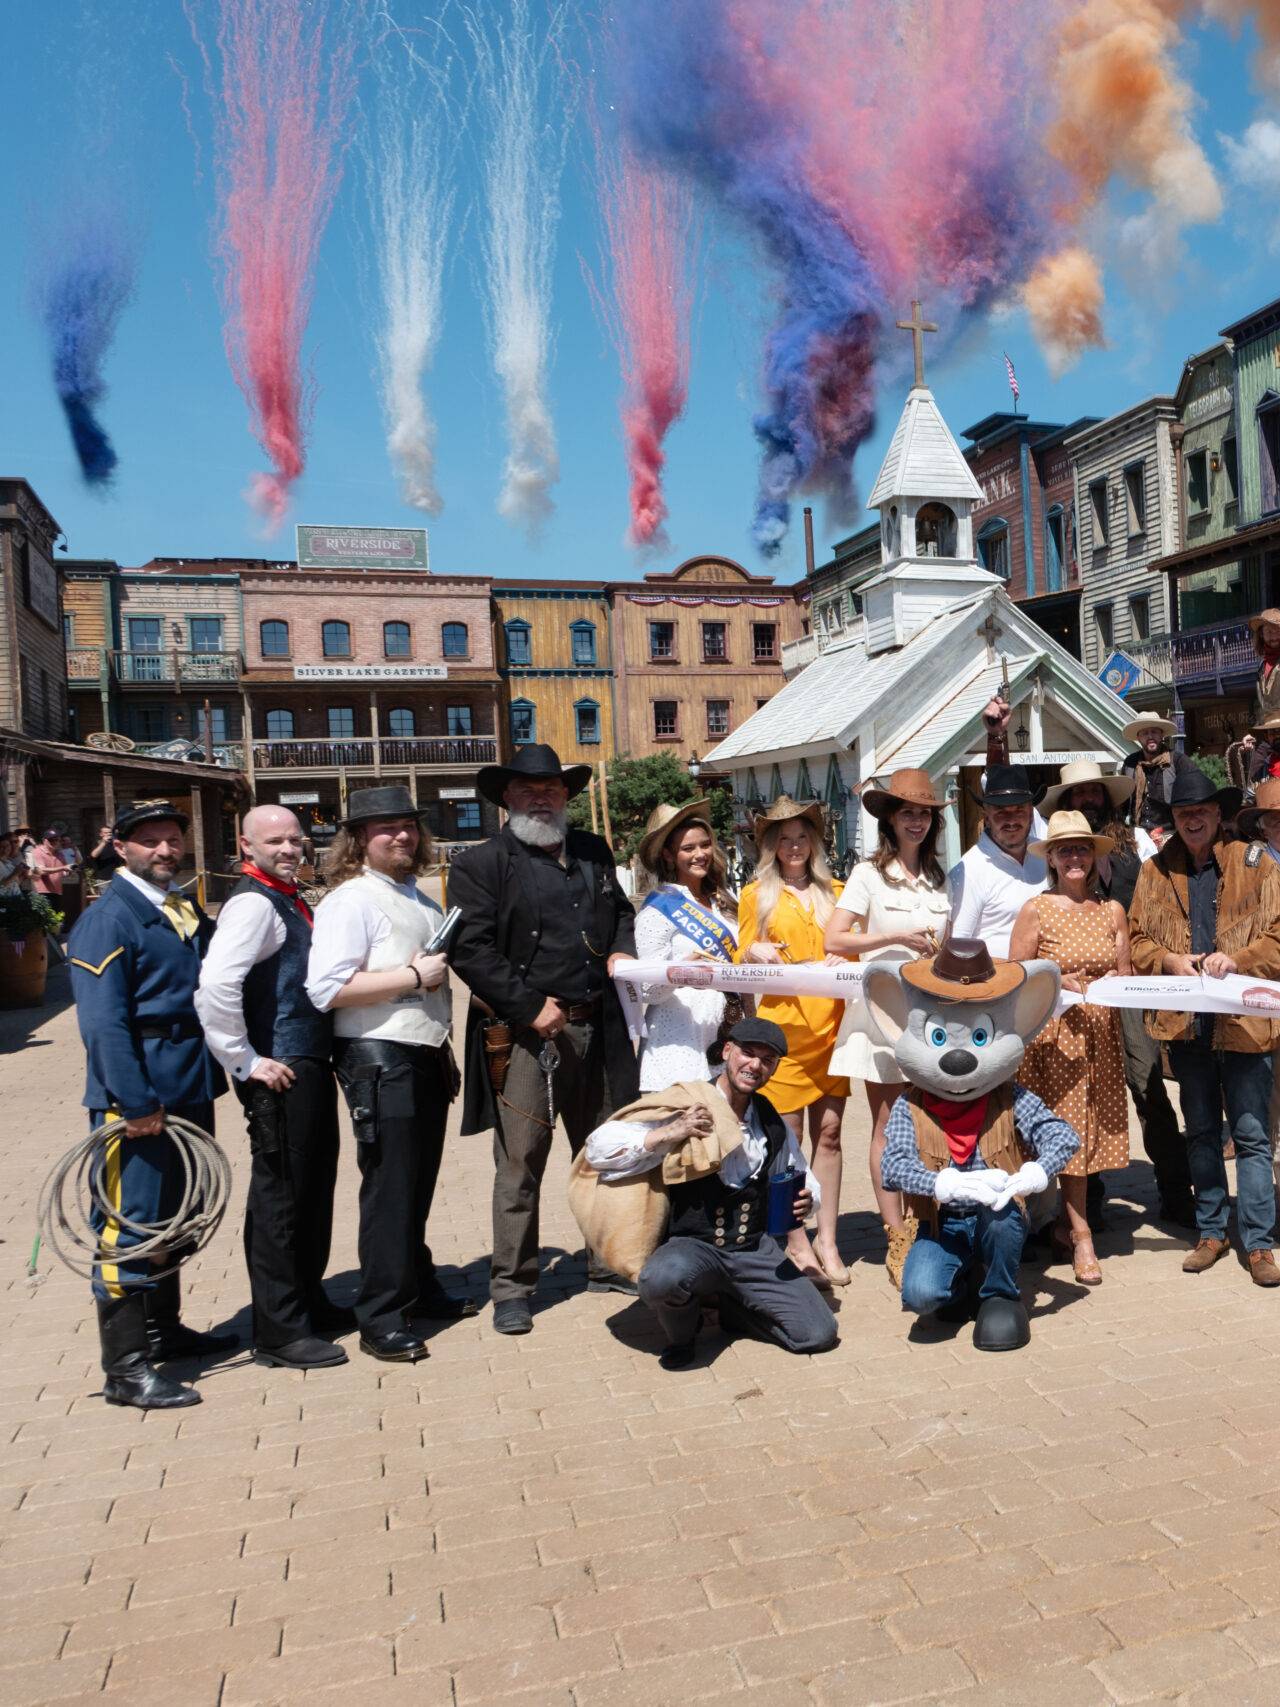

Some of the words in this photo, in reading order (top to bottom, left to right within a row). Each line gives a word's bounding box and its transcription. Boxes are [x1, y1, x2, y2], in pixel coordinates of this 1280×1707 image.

[326, 538, 401, 550] RIVERSIDE
[297, 668, 343, 676] SILVER
[347, 668, 380, 676] LAKE
[383, 668, 445, 676] GAZETTE.
[1020, 754, 1038, 763] SAN
[1042, 752, 1082, 763] ANTONIO
[681, 902, 724, 939] EUROPA
[671, 909, 706, 941] FACE
[701, 935, 720, 953] OF
[721, 967, 784, 977] RIVERSIDE
